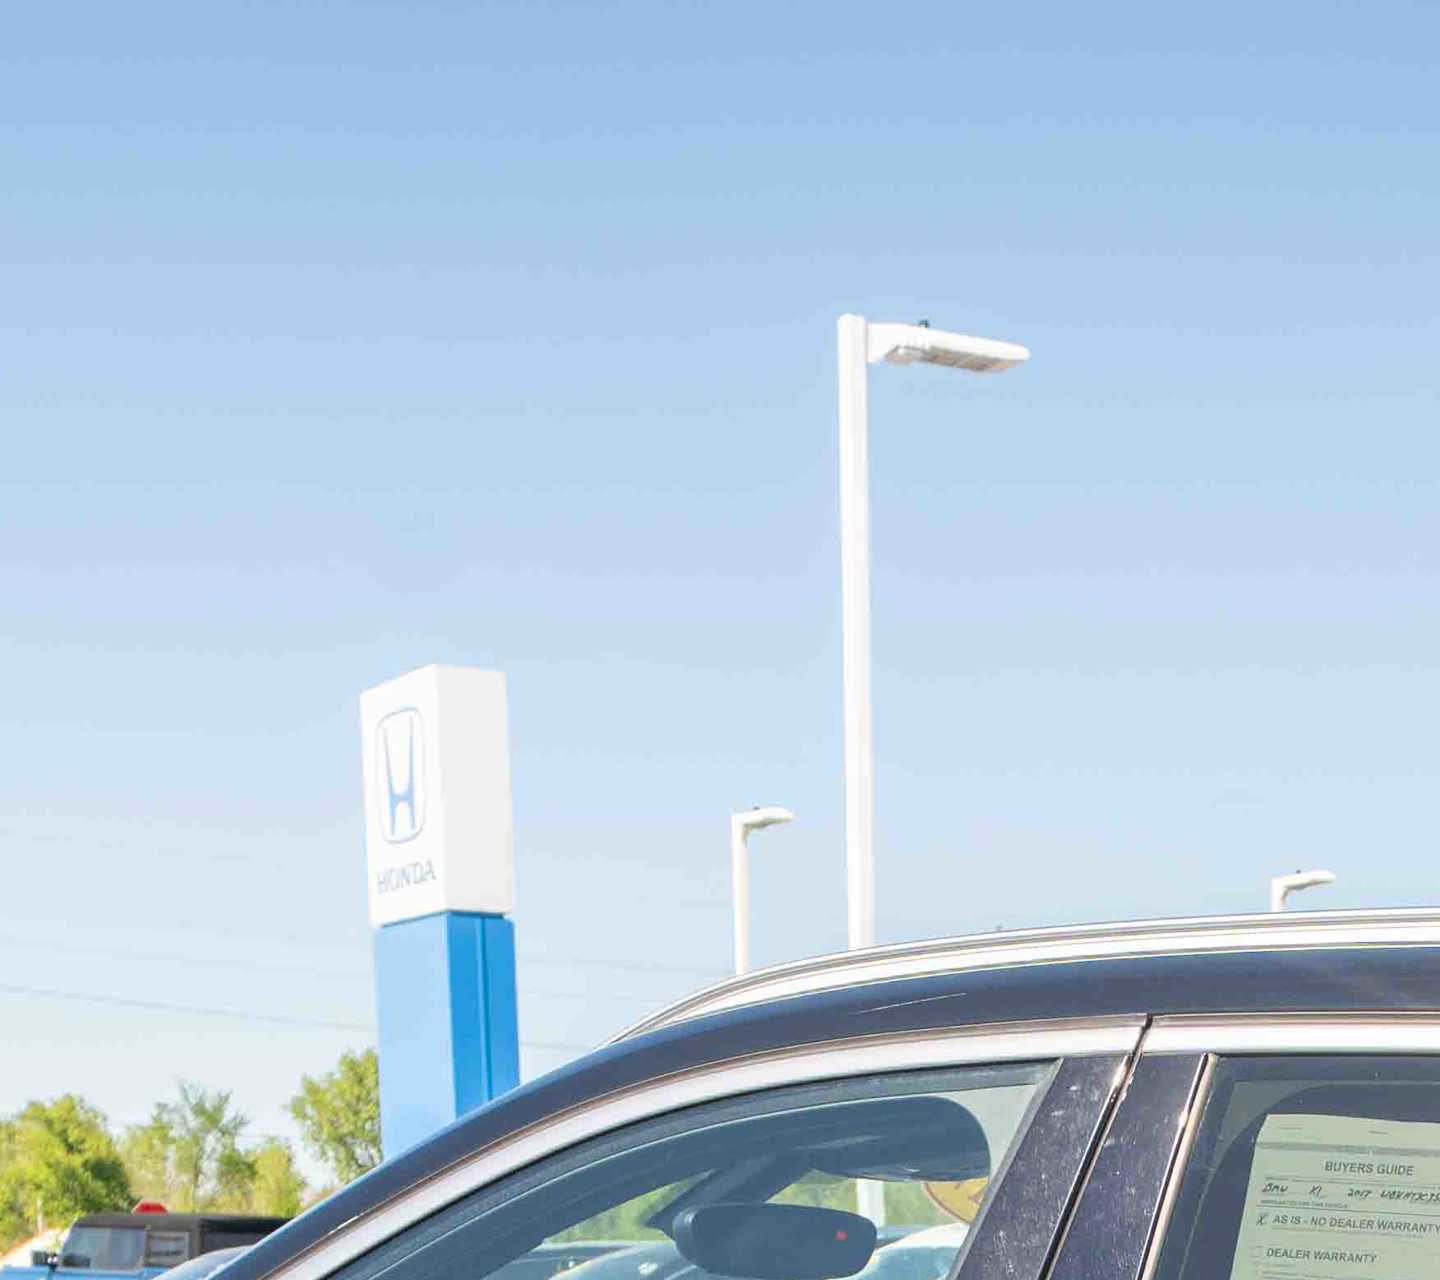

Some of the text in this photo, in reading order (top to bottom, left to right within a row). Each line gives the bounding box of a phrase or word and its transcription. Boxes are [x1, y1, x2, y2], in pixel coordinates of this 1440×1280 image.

[376, 859, 437, 894] HONDA
[1324, 1160, 1415, 1177] BUYERS GUIDE
[1272, 1214, 1288, 1225] AS
[1290, 1215, 1301, 1226] IS
[1310, 1216, 1328, 1227] NO
[1329, 1217, 1376, 1231] DEALER
[1266, 1247, 1377, 1264] DEALER WARRANTY
